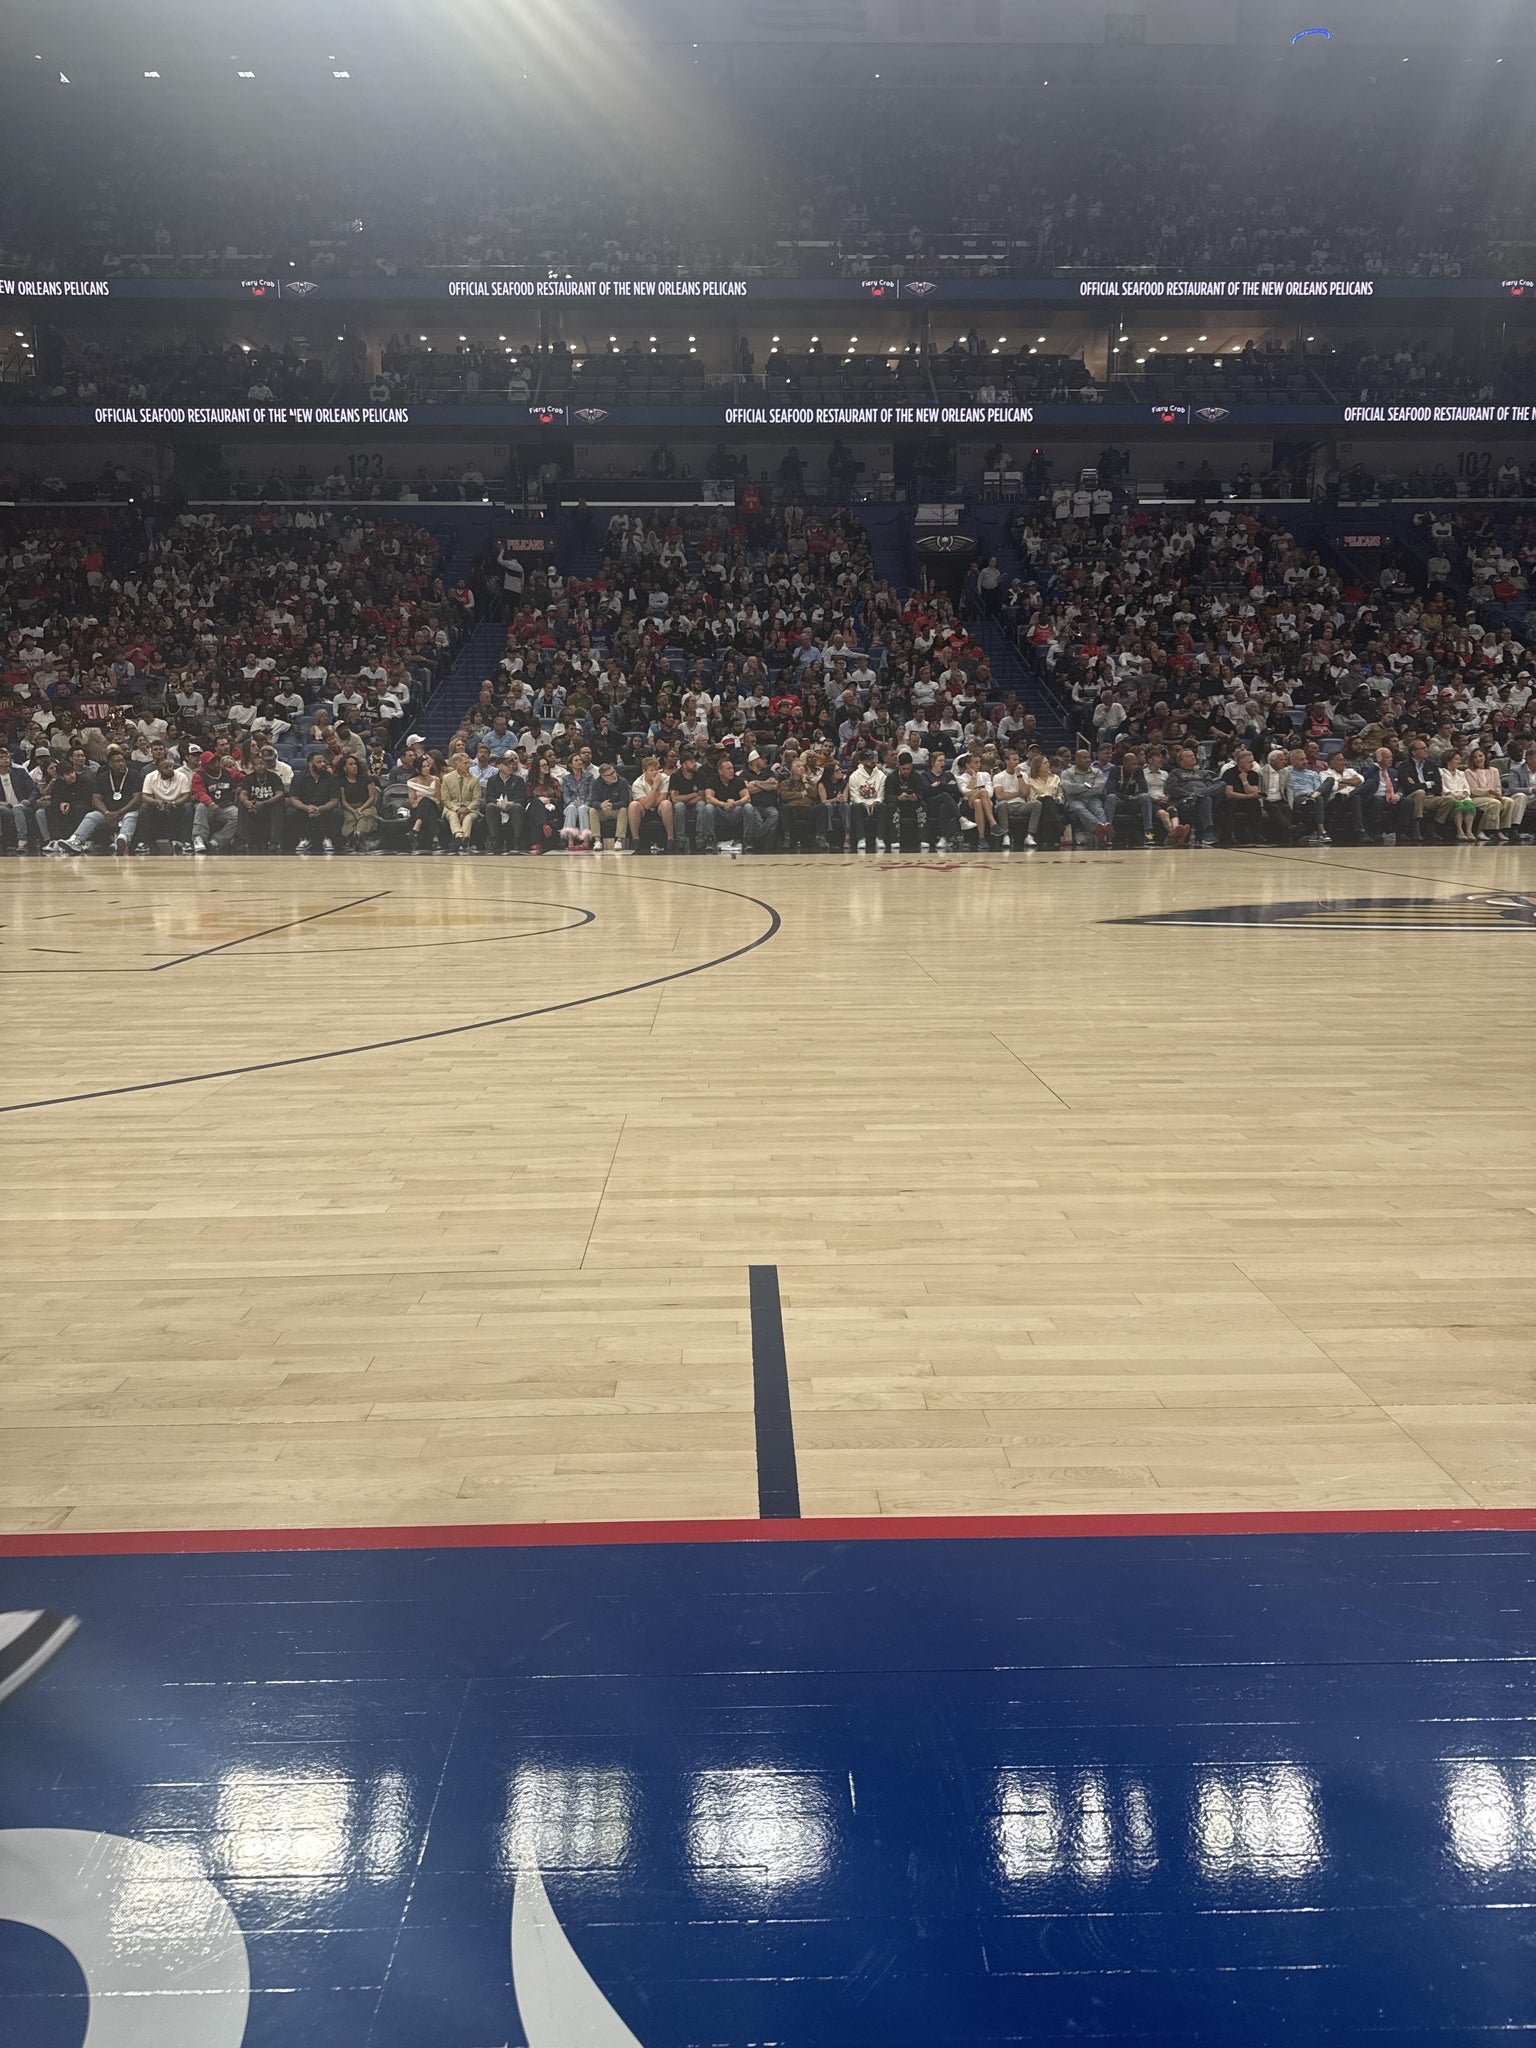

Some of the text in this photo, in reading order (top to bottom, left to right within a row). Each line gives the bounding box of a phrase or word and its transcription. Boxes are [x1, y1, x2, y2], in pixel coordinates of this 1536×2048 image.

[18, 281, 62, 295] ORLEANS
[64, 281, 110, 295] PELICANS
[449, 281, 747, 296] OFFICIAL SEAFOOD RESTAURANT OF THE NEW ORLEANS PELICANS
[1080, 281, 1374, 296] OFFICIAL SEAFOOD RESTAURANT OF THE NEW ORLEANS PELICANS
[95, 408, 138, 422] OFFICIAL
[140, 408, 185, 422] SEAFOOD
[188, 408, 250, 422] RESTAURANT
[253, 408, 266, 422] OF
[268, 408, 287, 422] THE
[316, 408, 360, 423] ORLEANS
[362, 408, 408, 423] PELICANS
[725, 408, 1033, 423] OFFICIAL SEAFOOD RESTAURANT OF THE NEW ORLEANS PELICANS
[1344, 407, 1385, 421] OFFICIAL
[1387, 407, 1431, 421] SEAFOOD
[1433, 407, 1495, 421] RESTAURANT
[1497, 407, 1510, 421] OF
[1512, 407, 1530, 421] THE
